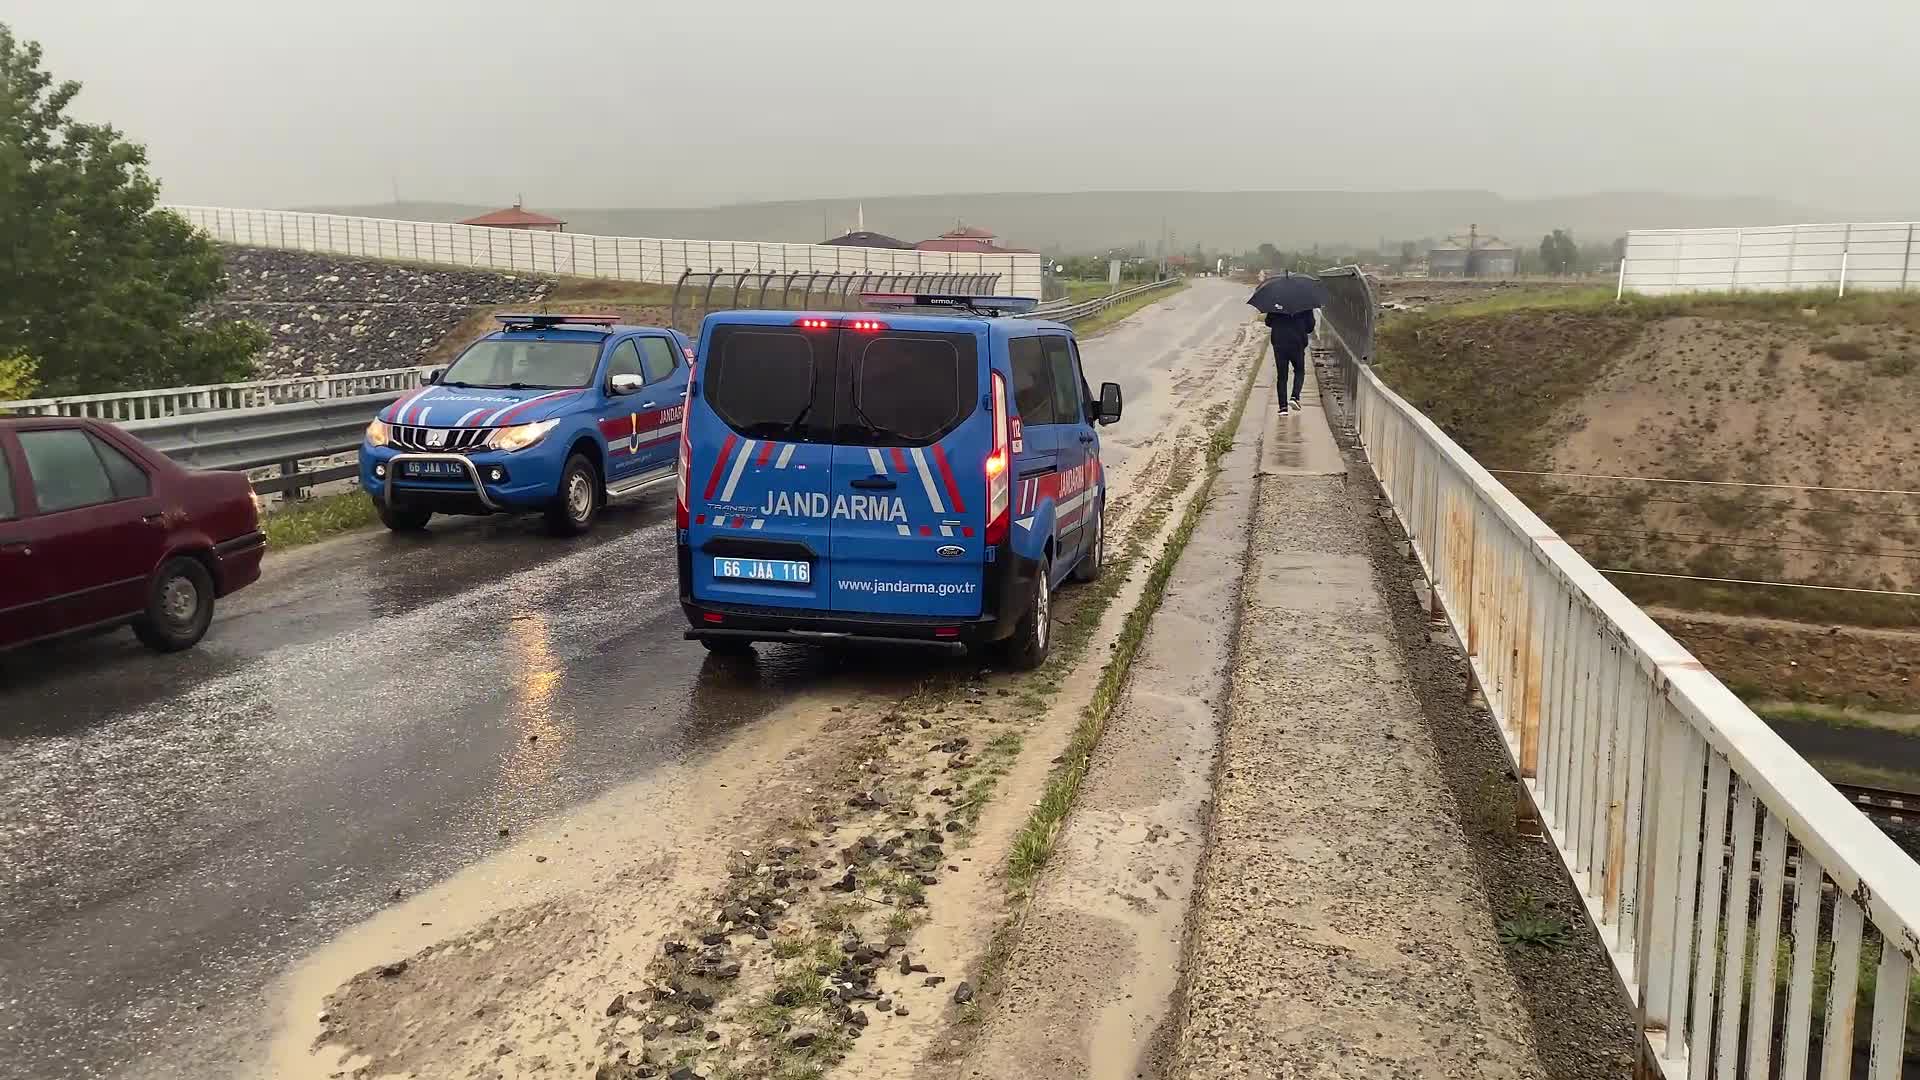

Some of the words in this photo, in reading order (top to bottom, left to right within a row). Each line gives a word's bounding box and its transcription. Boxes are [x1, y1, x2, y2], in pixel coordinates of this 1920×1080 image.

[659, 405, 684, 425] JANDAR
[1011, 419, 1021, 438] 112
[409, 463, 420, 472] 66
[424, 463, 440, 473] JAA
[446, 463, 461, 473] 145
[707, 503, 758, 513] TRANSIT
[760, 490, 908, 523] JANDARMA
[723, 561, 741, 577] 66
[749, 562, 774, 579] JAA
[783, 564, 807, 581] 116
[838, 579, 976, 597] www.jandarma.gov.tr
